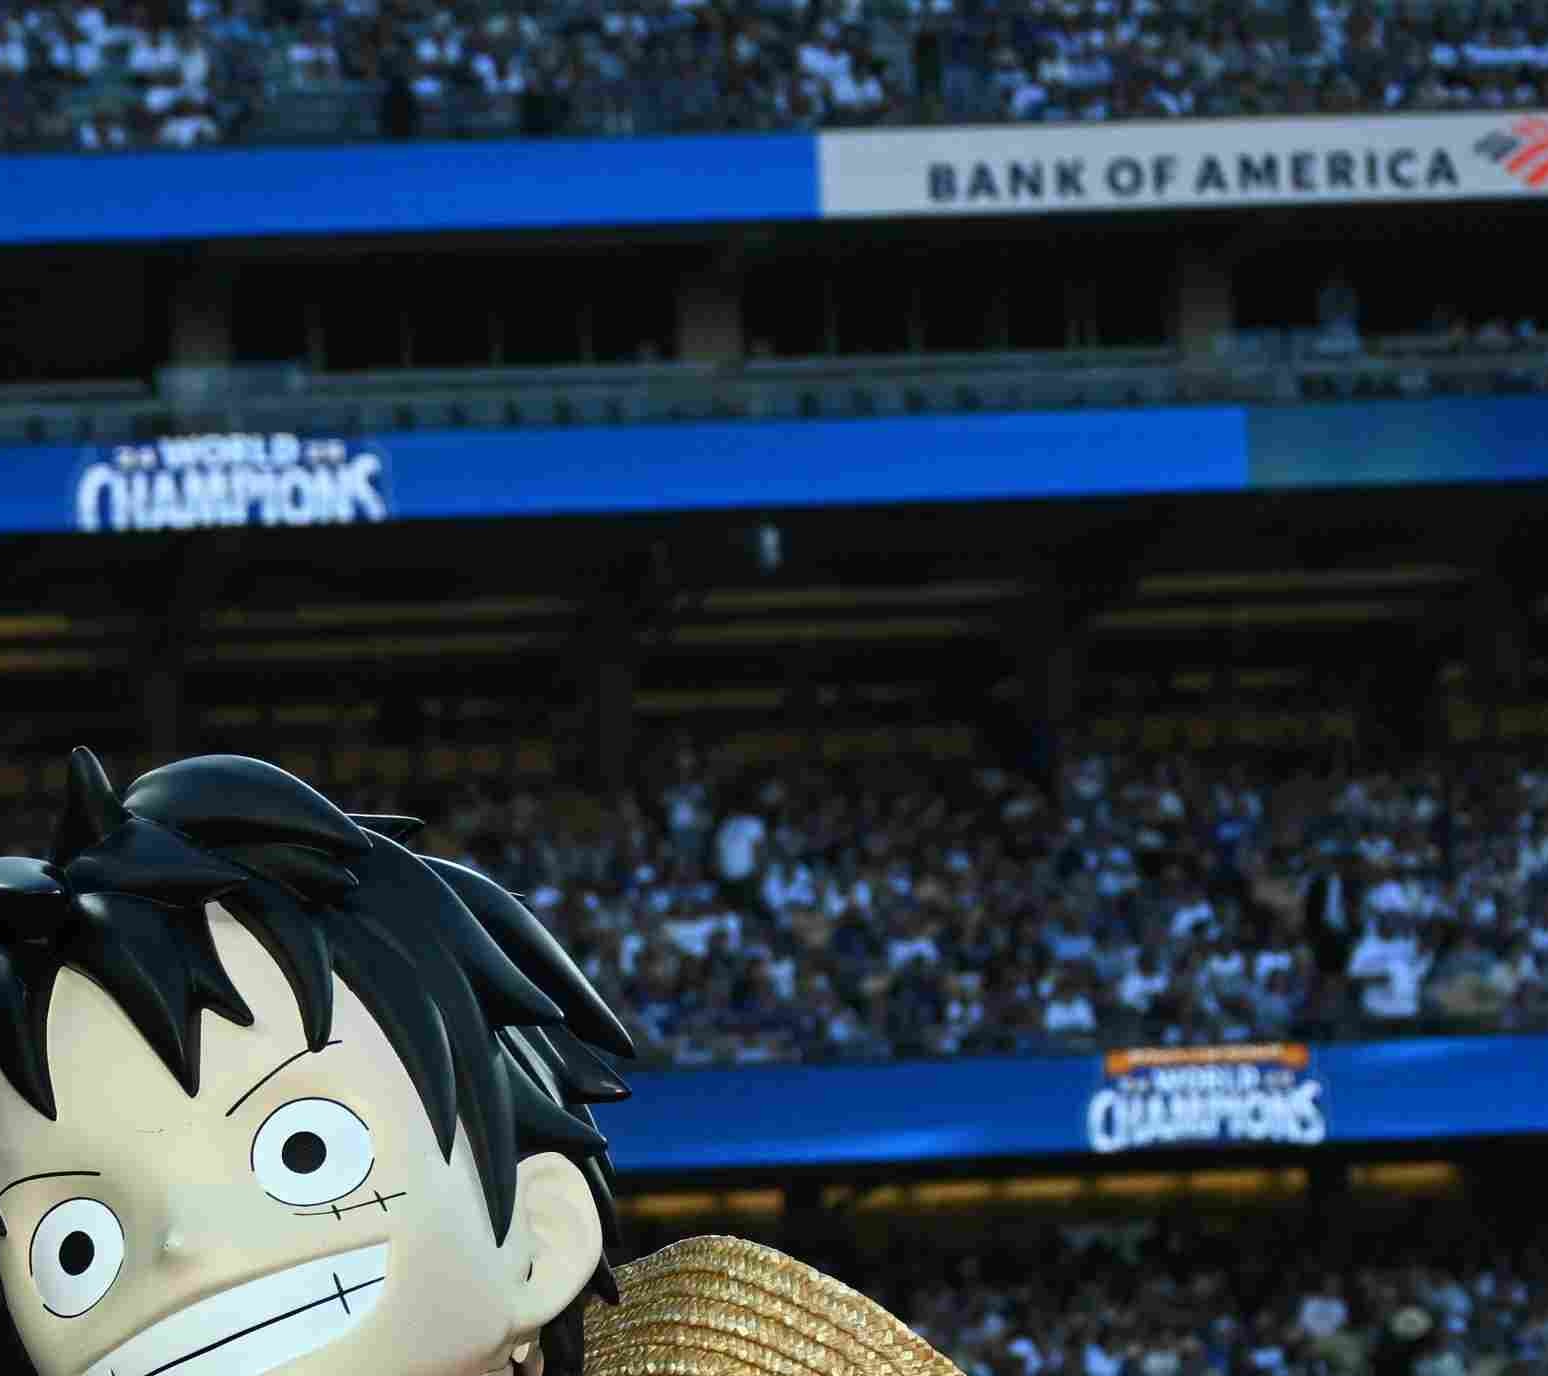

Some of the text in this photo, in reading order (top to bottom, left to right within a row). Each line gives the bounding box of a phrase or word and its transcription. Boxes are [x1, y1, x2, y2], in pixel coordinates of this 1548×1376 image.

[926, 145, 1460, 202] BANK OF AMERICA
[1087, 1080, 1326, 1154] CHAMPIONS
